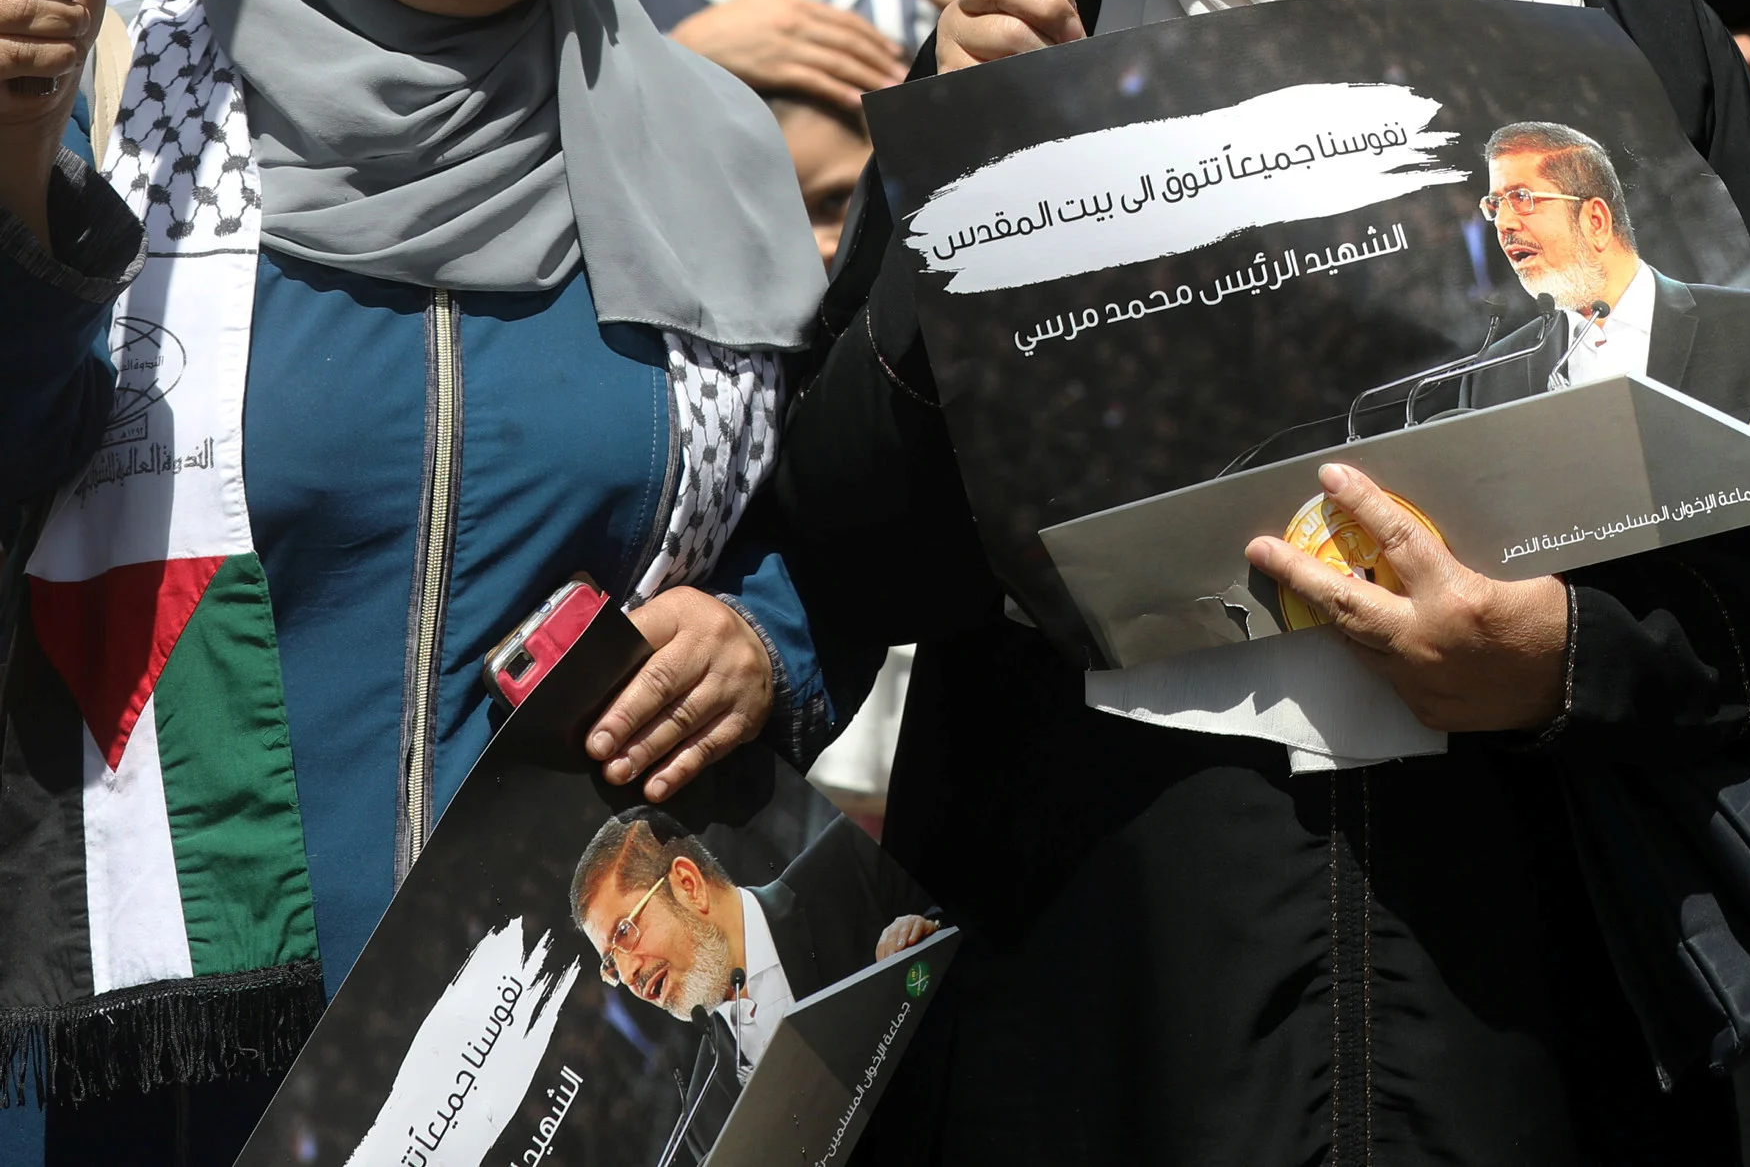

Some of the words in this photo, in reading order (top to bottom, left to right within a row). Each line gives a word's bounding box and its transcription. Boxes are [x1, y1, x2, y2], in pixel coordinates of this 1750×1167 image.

[1316, 121, 1408, 160] نفوسنا
[1121, 174, 1155, 213] الى
[1161, 156, 1222, 203] تتوق
[1057, 190, 1113, 224] بيت
[932, 201, 1052, 260] المقدس
[1304, 223, 1409, 275] الشهيد
[1199, 249, 1300, 304] الرئيس
[1106, 285, 1192, 324] محمد
[1014, 307, 1100, 356] مرسي
[162, 436, 214, 475] الندوة
[1672, 492, 1717, 522] الإخوان
[1502, 536, 1540, 563] النصر
[461, 975, 523, 1069] نفوسنا
[883, 1001, 911, 1045] جماعة
[863, 1042, 888, 1089] الإخوان
